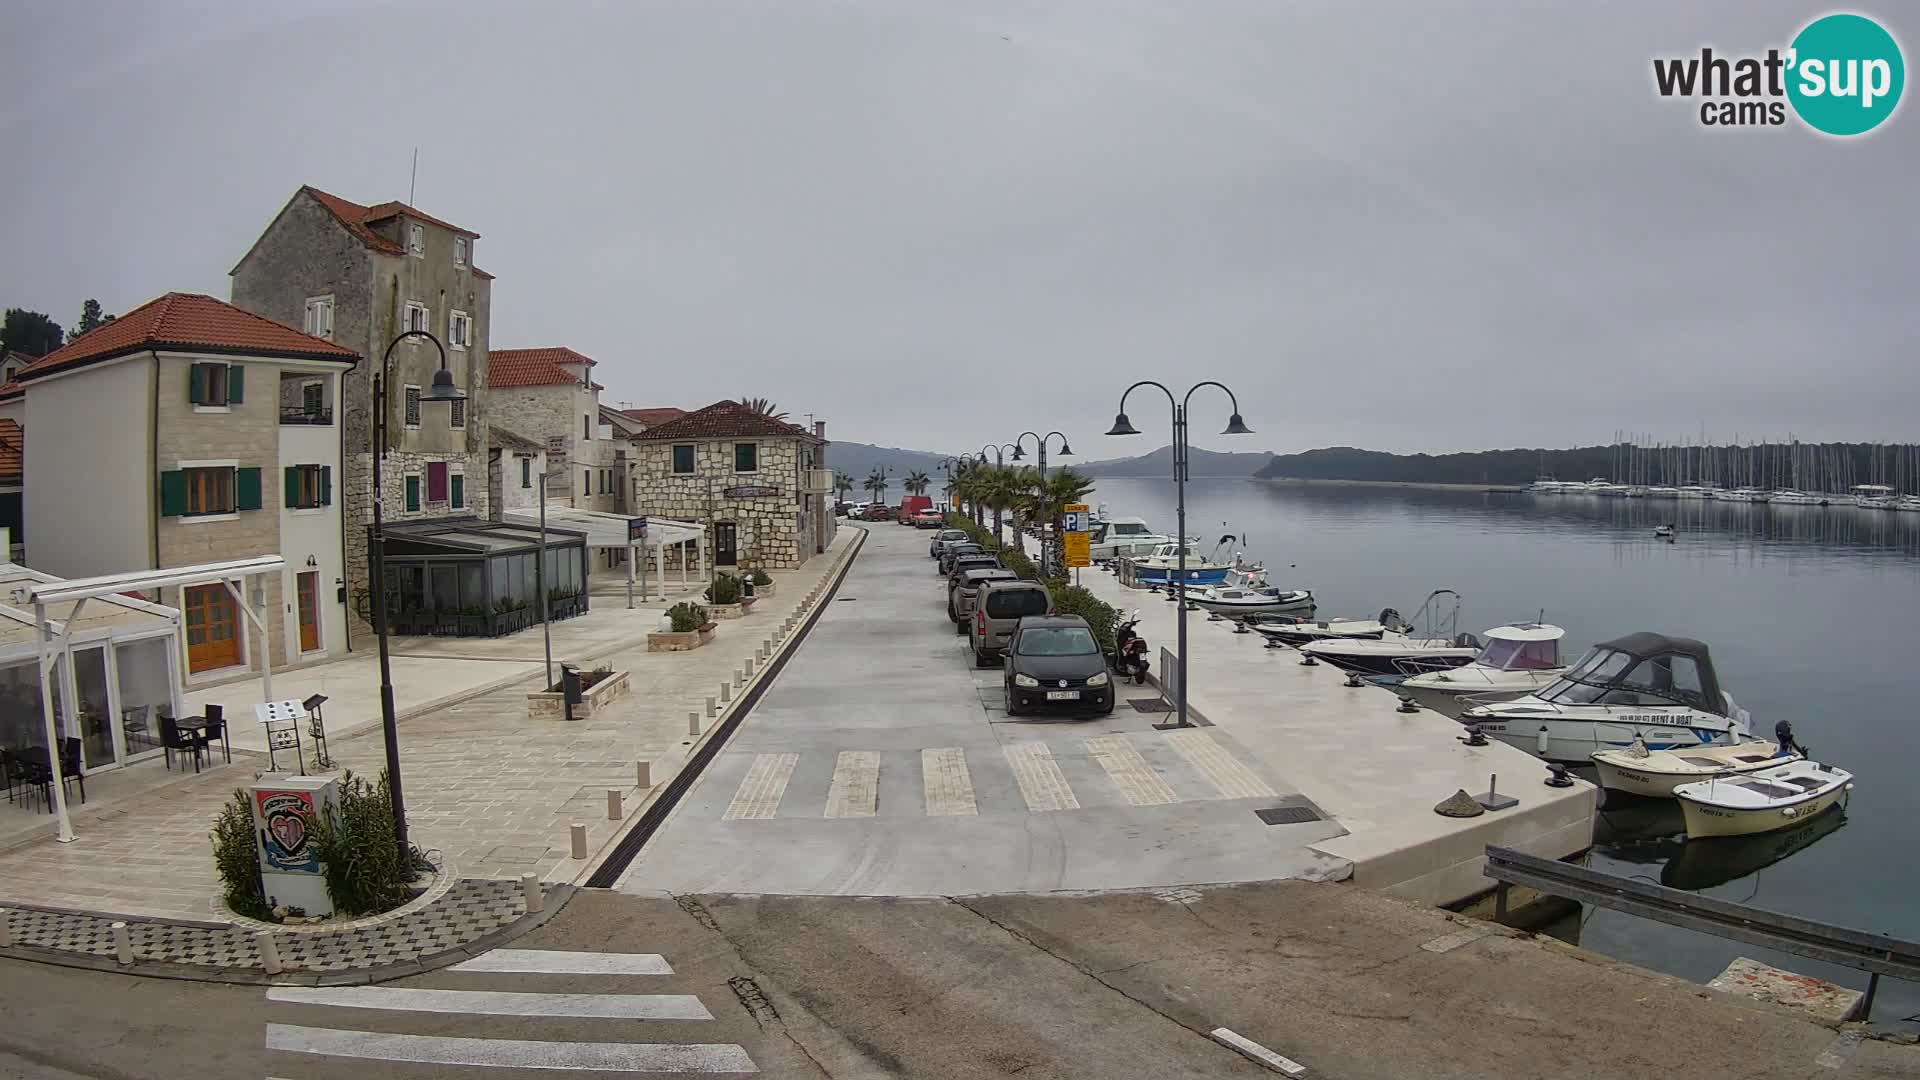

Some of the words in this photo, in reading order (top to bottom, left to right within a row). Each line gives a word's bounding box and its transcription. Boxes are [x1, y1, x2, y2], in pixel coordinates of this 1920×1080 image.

[1651, 714, 1669, 723] RENT
[1670, 715, 1675, 724] A
[1676, 715, 1693, 725] BOAT
